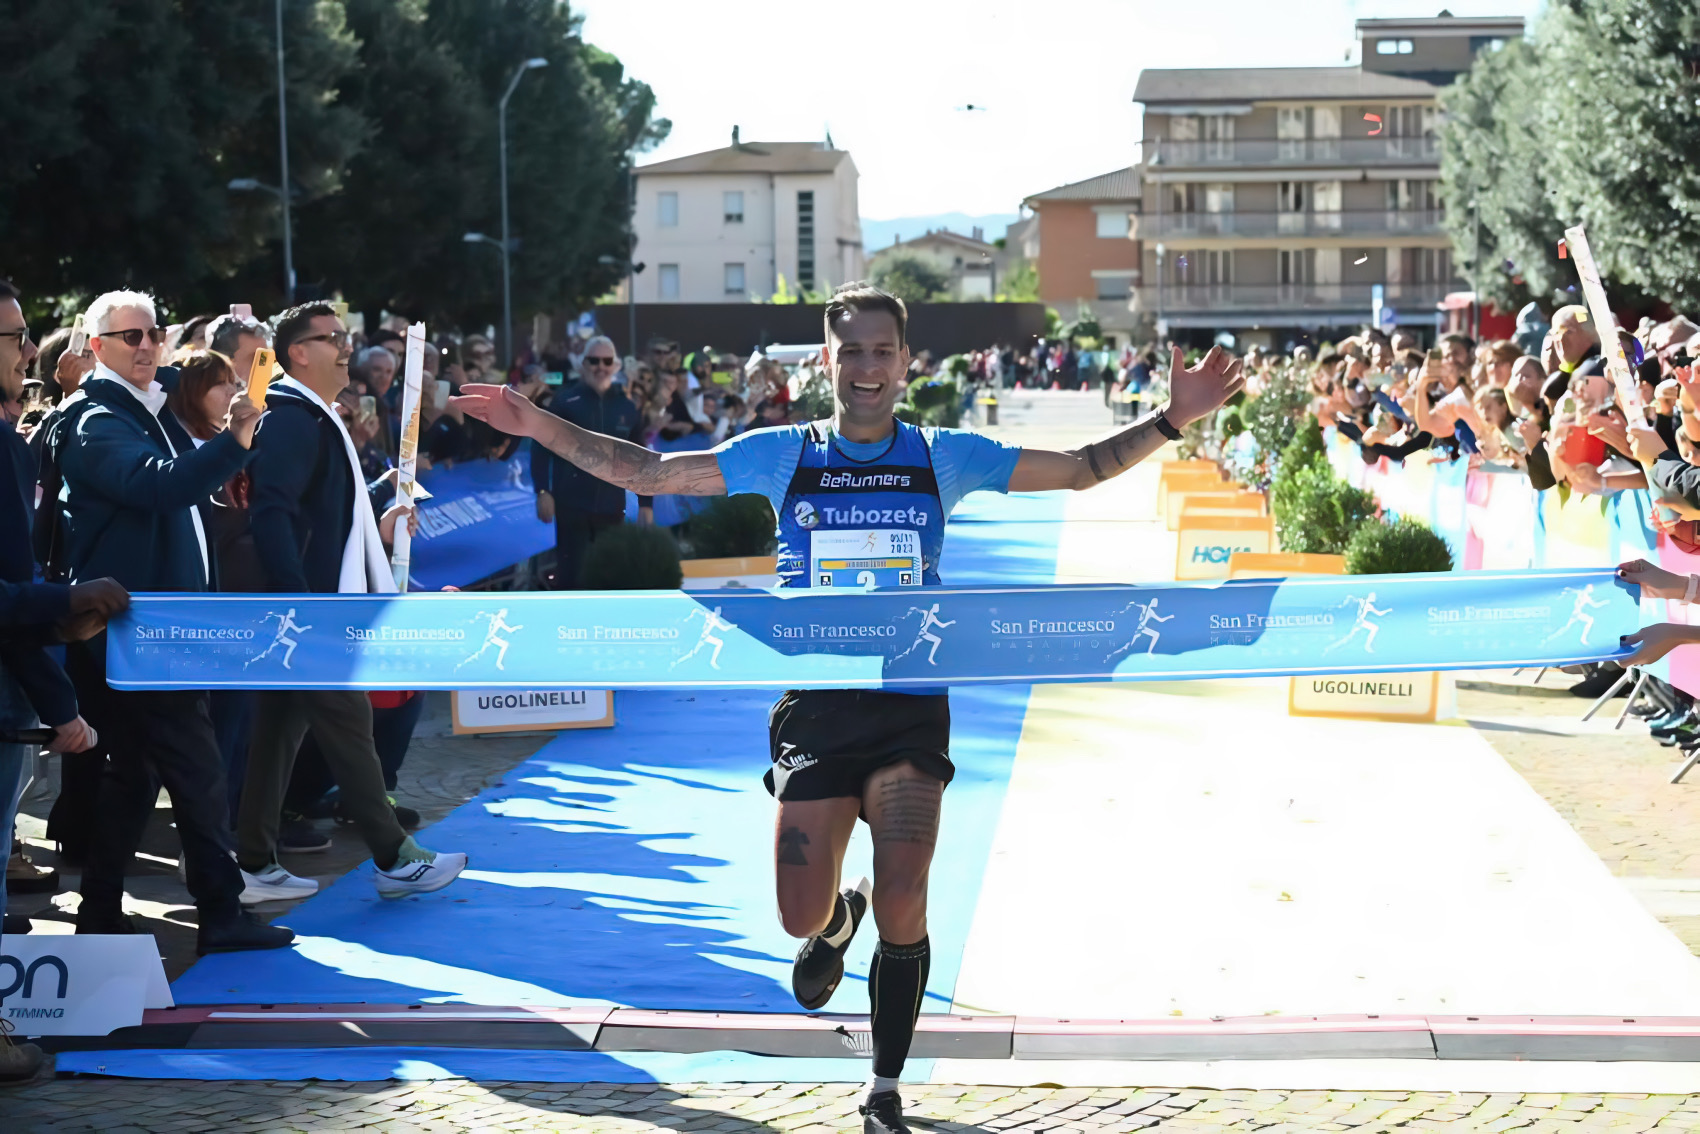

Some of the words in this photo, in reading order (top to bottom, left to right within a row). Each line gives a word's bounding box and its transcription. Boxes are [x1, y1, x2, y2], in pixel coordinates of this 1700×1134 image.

[819, 472, 911, 488] BeRunners
[823, 505, 928, 527] Tubozeta
[991, 619, 1023, 635] San
[1028, 619, 1115, 634] Francesco
[1210, 614, 1241, 629] San
[1247, 612, 1335, 628] Francesco
[135, 625, 165, 640] San
[170, 624, 255, 640] Francesco
[345, 625, 376, 641] San
[381, 625, 465, 641] Francesco
[557, 625, 588, 640] San
[594, 625, 680, 640] Francesco
[772, 624, 804, 638] San
[810, 623, 897, 638] Francesco
[1313, 680, 1413, 697] UGOLINELLI
[478, 690, 586, 710] UGOLINELLI
[8, 1007, 65, 1019] TIMING
